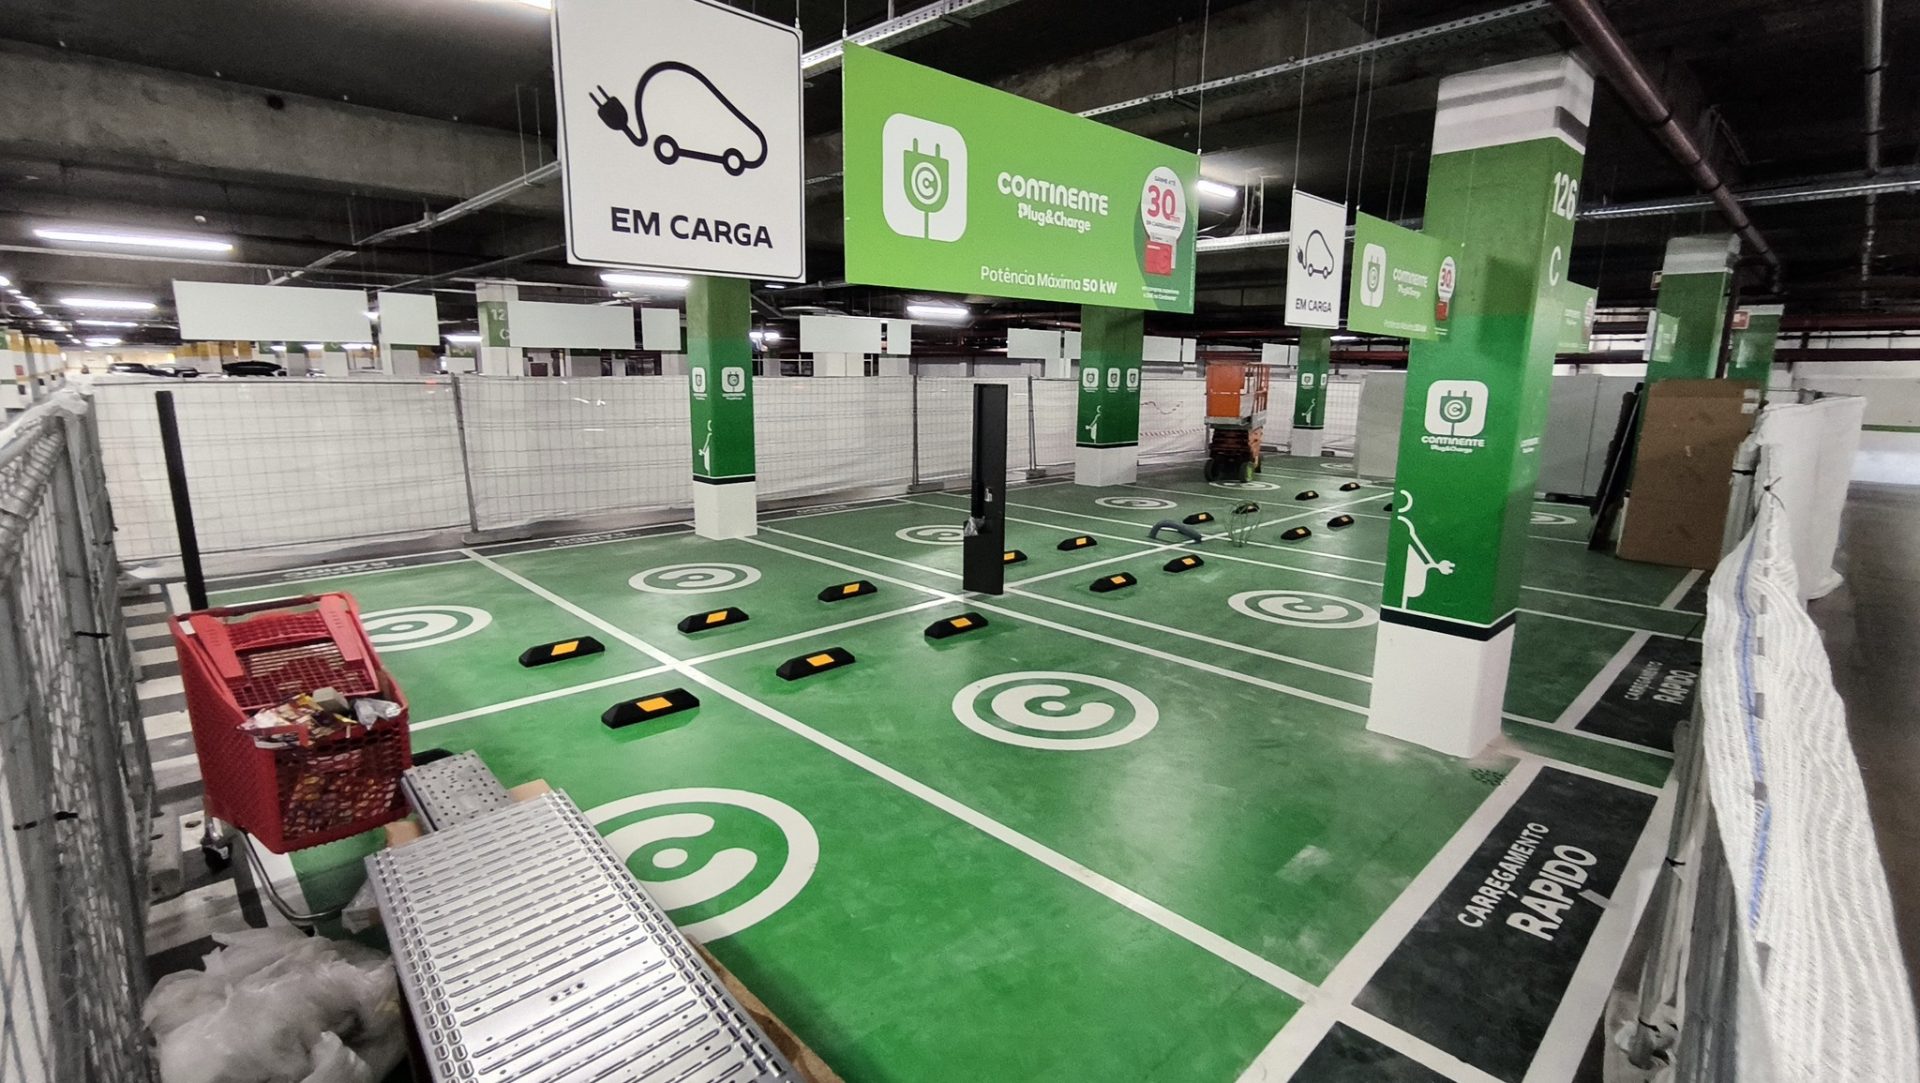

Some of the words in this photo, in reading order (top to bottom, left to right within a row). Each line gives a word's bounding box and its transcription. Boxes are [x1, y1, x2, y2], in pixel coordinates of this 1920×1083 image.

[997, 171, 1109, 216] CONTINENTE
[1147, 184, 1176, 221] 30
[1552, 171, 1578, 220] 126
[611, 206, 661, 236] EM
[670, 214, 774, 249] CARGA
[1018, 202, 1092, 233] Plug&Charge
[981, 265, 1036, 286] Potência
[1037, 272, 1081, 291] Máxima
[1082, 278, 1099, 292] 50
[1099, 279, 1118, 294] kW
[1549, 245, 1562, 286] C
[490, 308, 506, 321] 12
[1295, 298, 1307, 310] EM
[1307, 300, 1333, 313] CARGA
[1420, 436, 1486, 448] CONTINENTE
[1457, 822, 1550, 928] CARREGAMENTO
[1505, 844, 1598, 942] RÁPIDO
